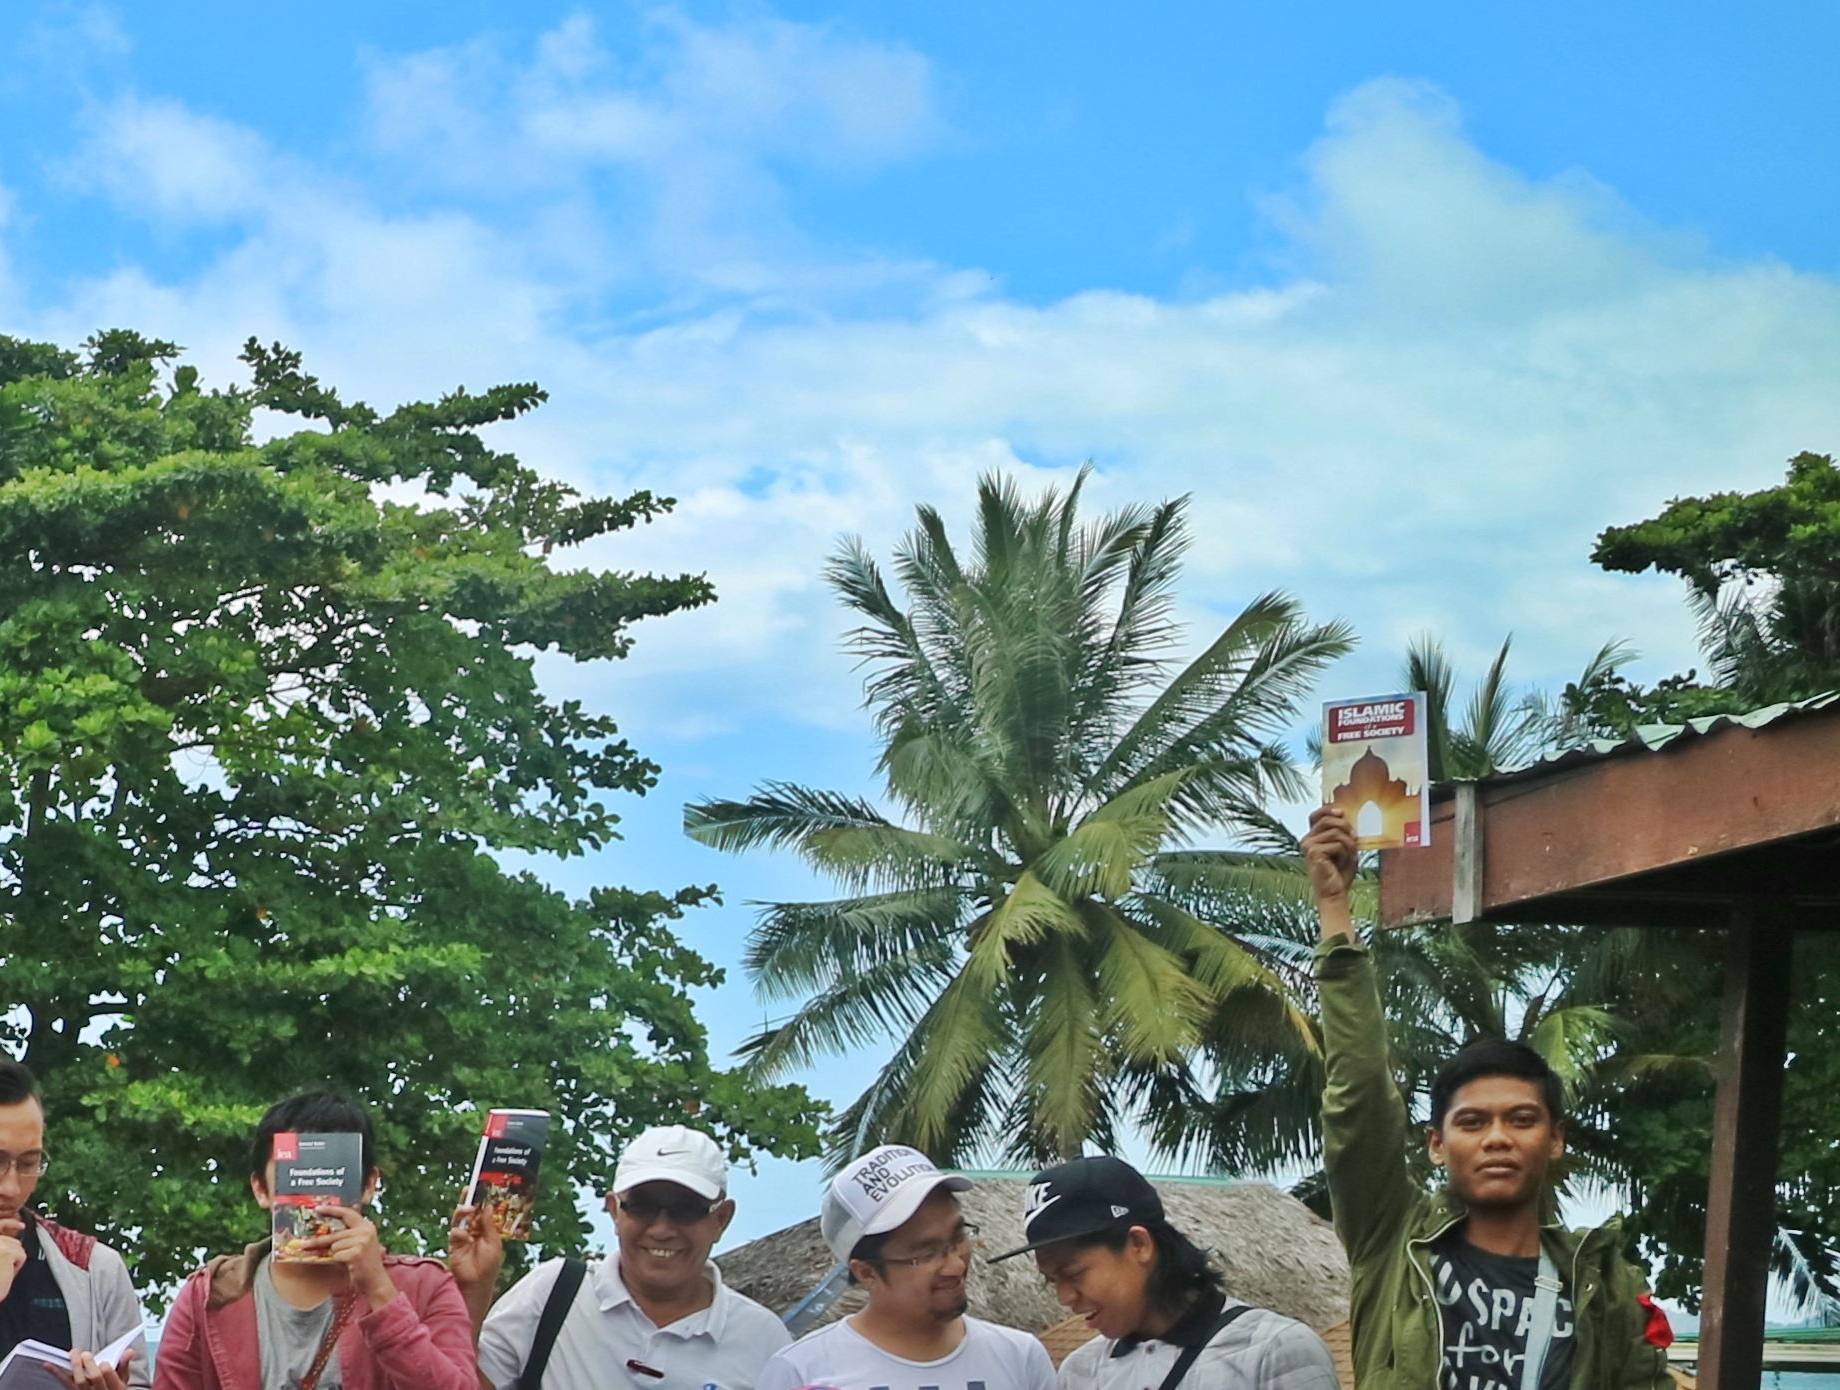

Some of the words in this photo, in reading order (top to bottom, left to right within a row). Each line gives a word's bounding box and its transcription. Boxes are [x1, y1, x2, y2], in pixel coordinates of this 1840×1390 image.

[1338, 702, 1406, 720] ISLAMIC
[1337, 713, 1404, 727] FOUNDATIONS
[1337, 730, 1361, 741] FREE
[1363, 726, 1406, 738] SOCIETY
[277, 1149, 292, 1159] iea
[289, 1167, 334, 1177] Foundations
[335, 1166, 346, 1176] of
[297, 1178, 315, 1186] Free
[315, 1178, 344, 1188] Society
[861, 1167, 891, 1196] AND
[1467, 1277, 1575, 1338] SPAC
